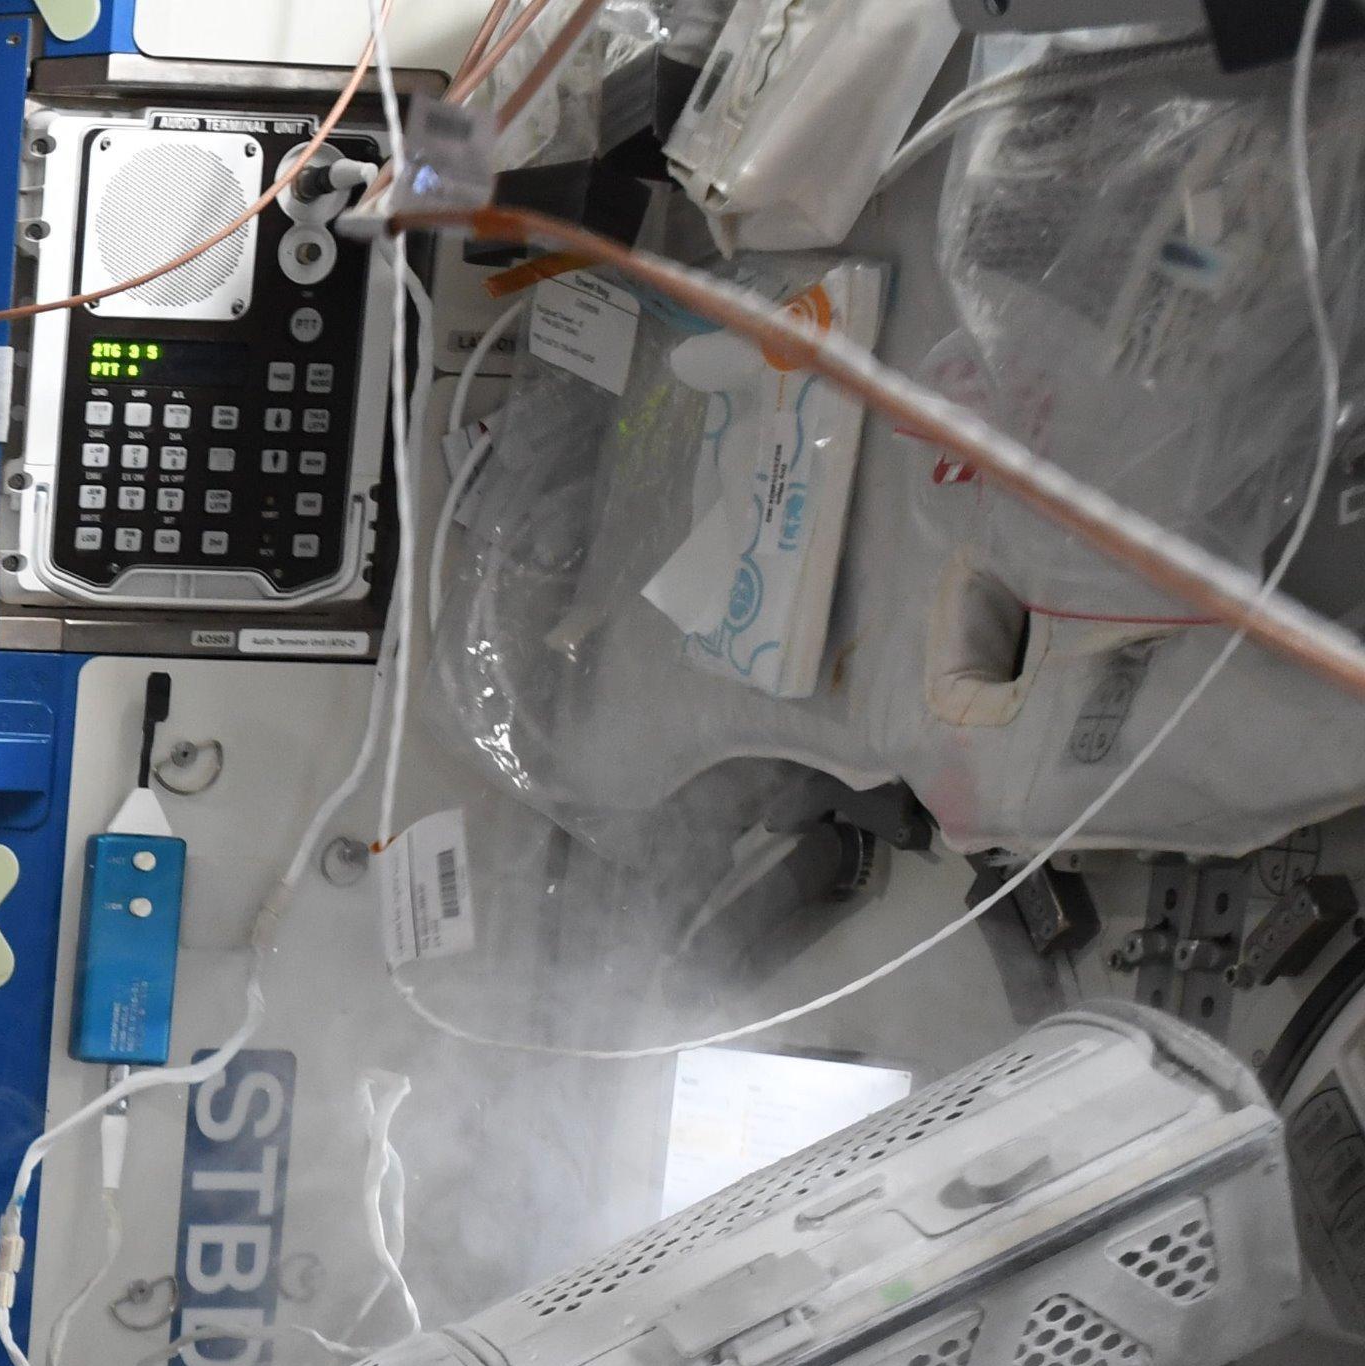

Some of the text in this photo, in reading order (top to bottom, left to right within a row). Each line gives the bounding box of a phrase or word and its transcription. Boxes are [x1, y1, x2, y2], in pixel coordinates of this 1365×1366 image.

[158, 116, 305, 135] AUDIO TERMINAL UNIT
[90, 361, 120, 376] PTT
